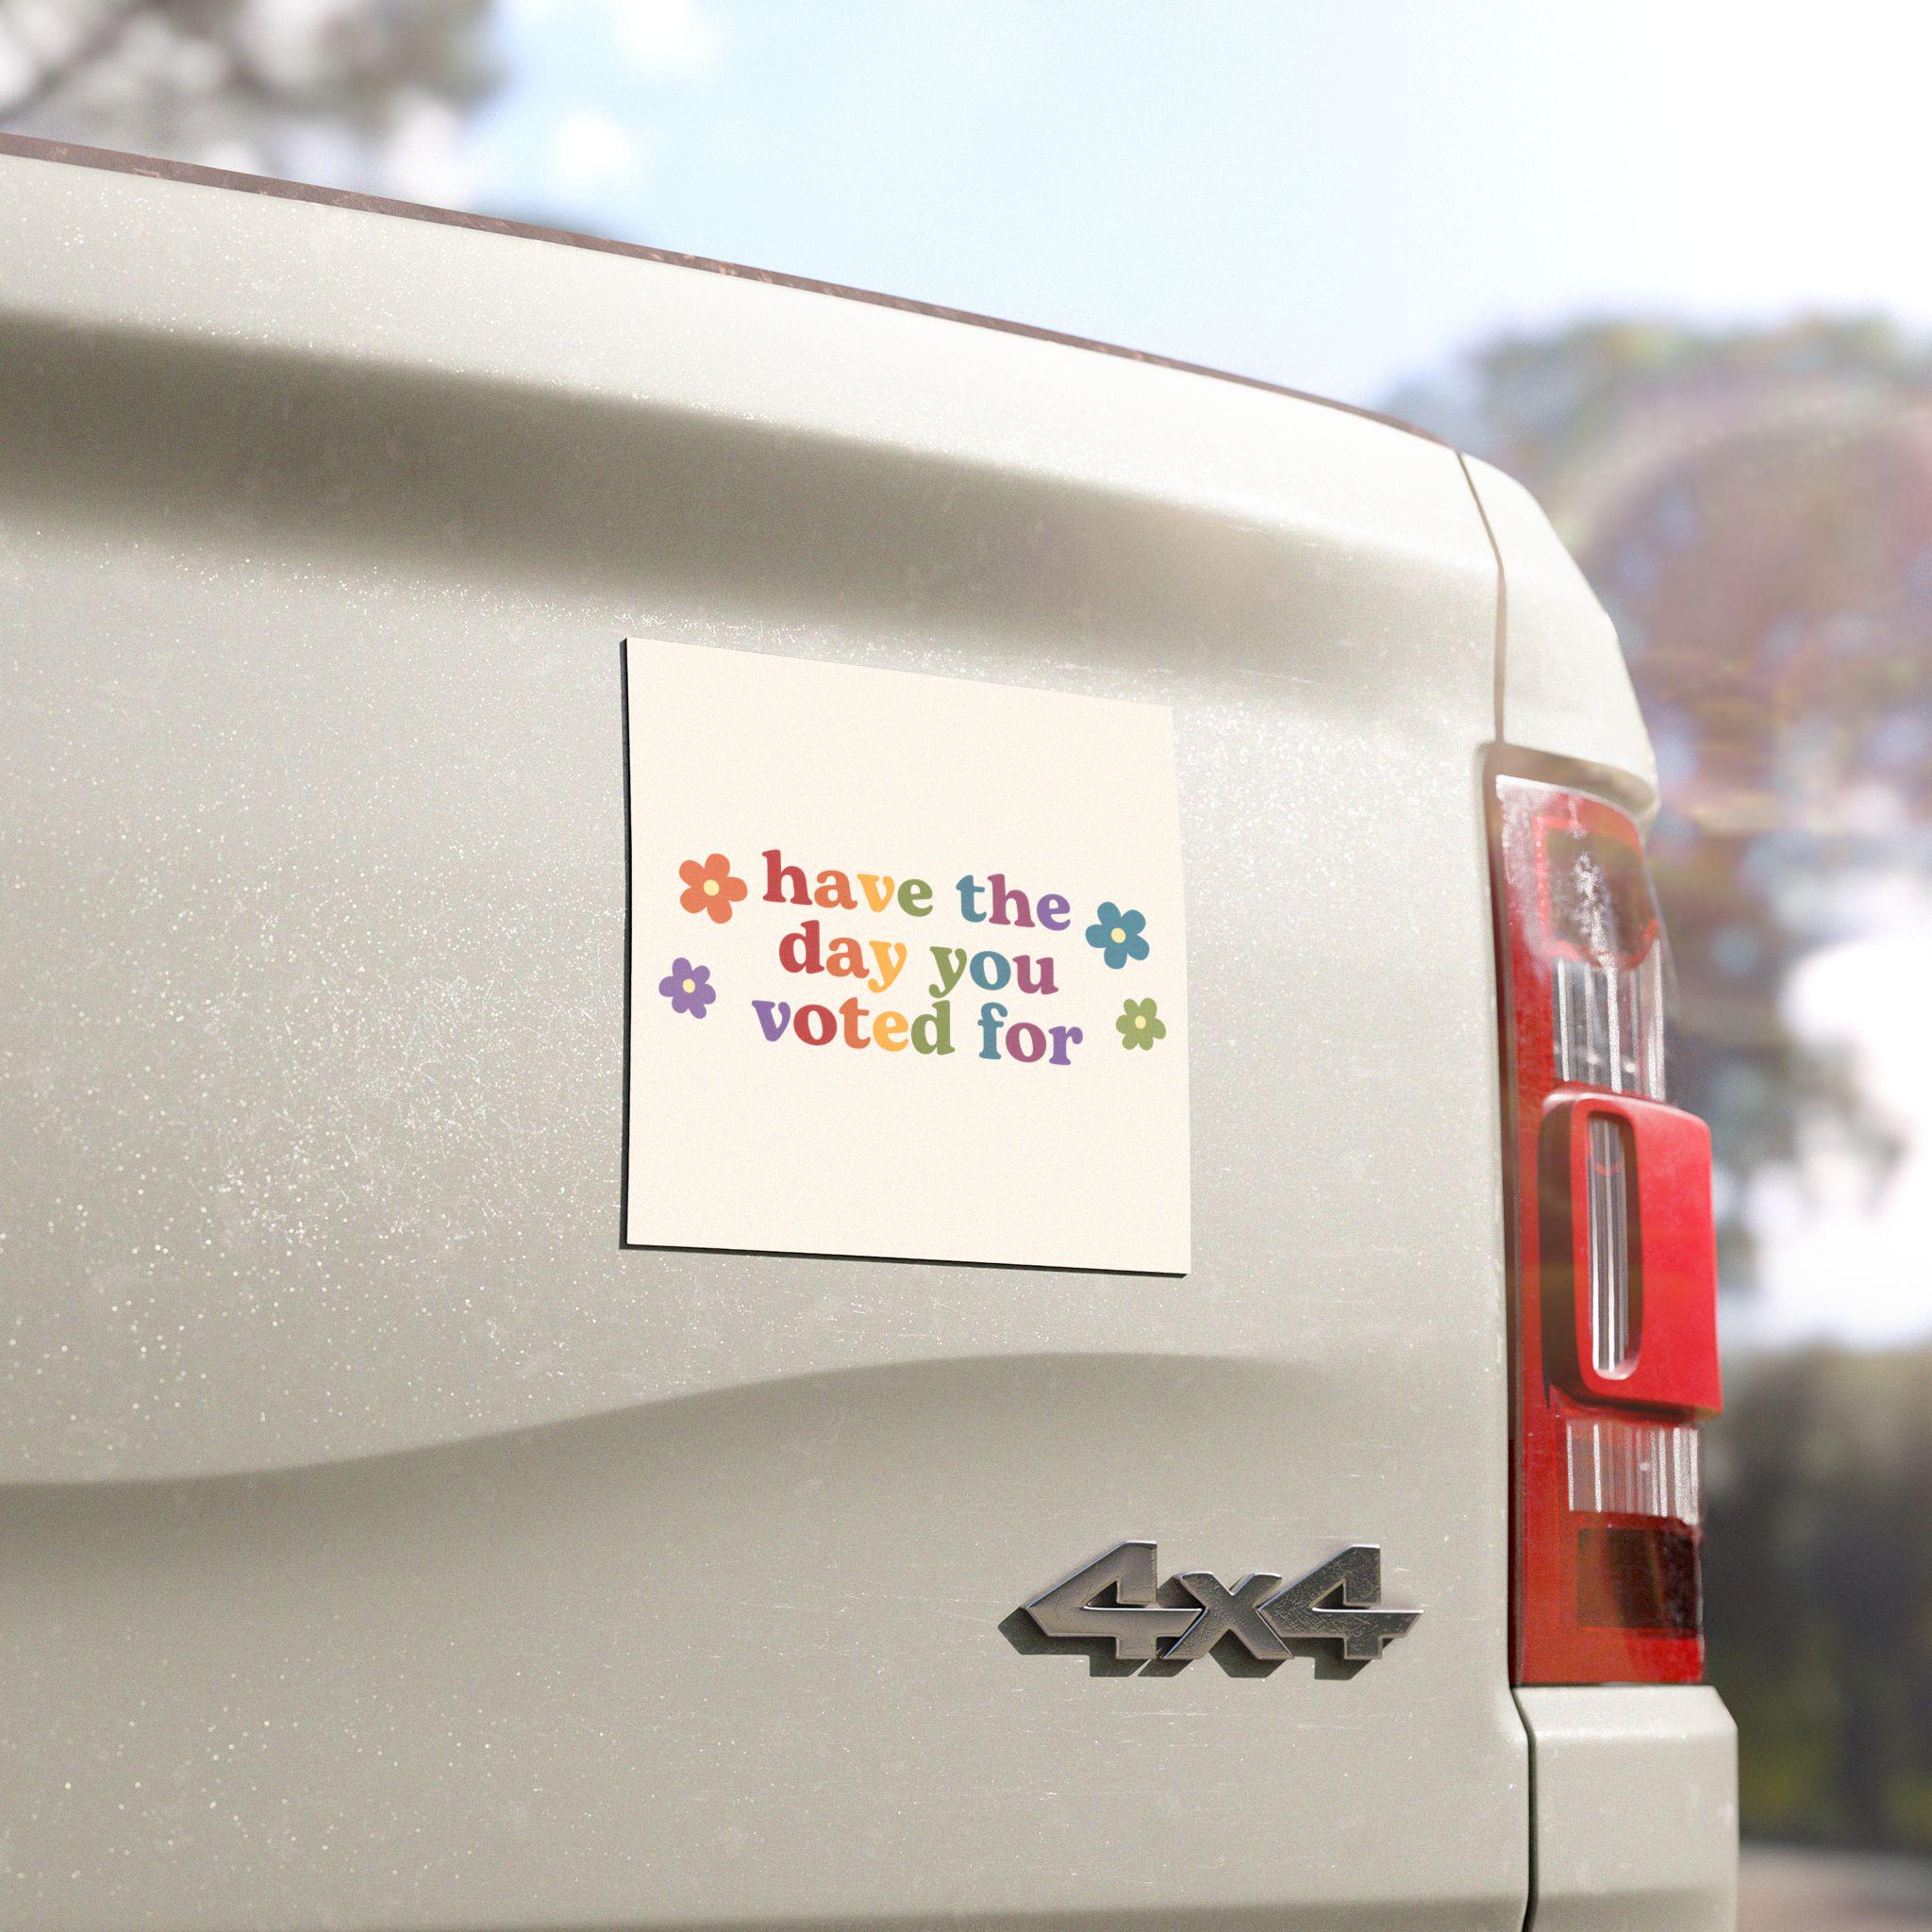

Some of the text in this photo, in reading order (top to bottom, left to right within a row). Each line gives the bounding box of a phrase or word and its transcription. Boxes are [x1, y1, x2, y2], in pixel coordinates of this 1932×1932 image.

[761, 849, 1071, 931] have the
[778, 919, 1058, 999] day you
[752, 996, 1083, 1066] voted for
